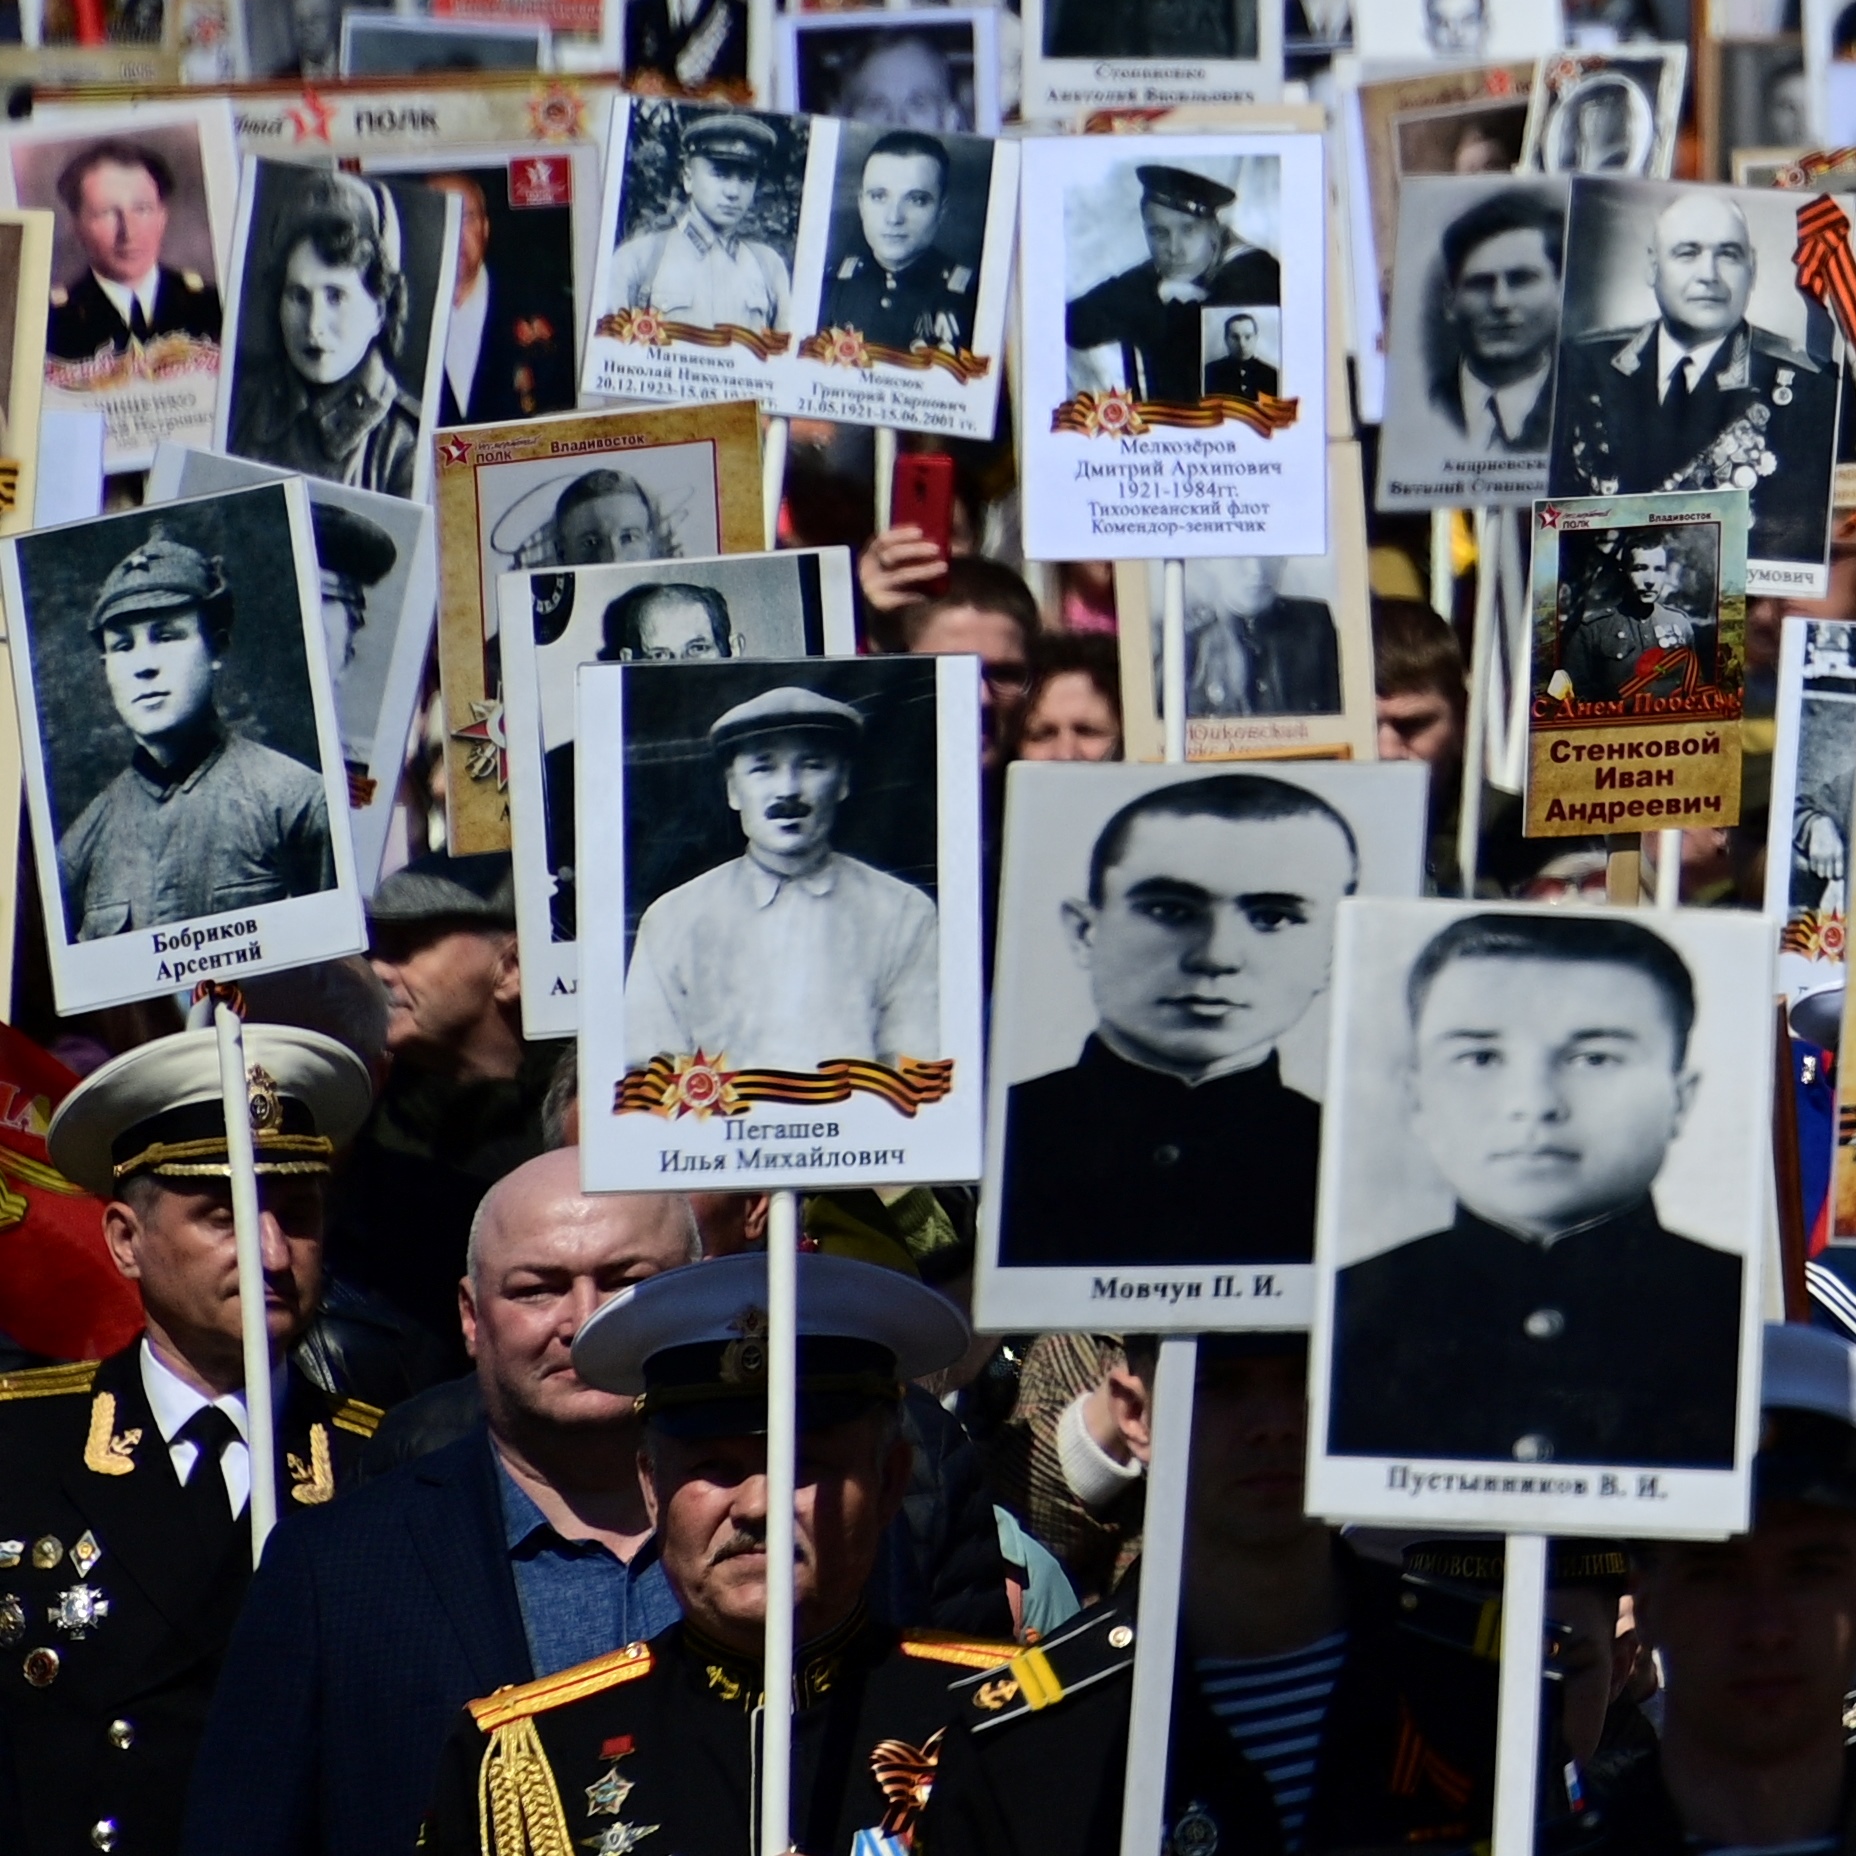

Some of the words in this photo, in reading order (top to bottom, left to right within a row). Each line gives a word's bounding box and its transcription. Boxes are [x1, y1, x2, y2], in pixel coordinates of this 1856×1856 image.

[356, 107, 438, 134] ПОЛК
[550, 434, 645, 454] Владивосток
[1120, 438, 1237, 458] Мелкозёров
[476, 451, 512, 463] ПОЛК
[1075, 460, 1164, 482] Дмитрий
[1171, 461, 1283, 481] Архипович
[1118, 482, 1240, 500] 1921-1984гг.
[1087, 500, 1222, 518] Тихоокеанский
[1227, 500, 1271, 519] флот
[1648, 511, 1712, 523] Владивосток
[1091, 518, 1266, 536] Комендор-зенитчик
[1747, 568, 1815, 585] умович
[1549, 731, 1720, 764] Стенковой
[1595, 766, 1674, 790] Иван
[1545, 795, 1721, 825] Андреевич
[152, 917, 260, 954] Бобриков
[155, 940, 264, 984] Арсентий
[723, 1118, 842, 1144] Пегашев
[658, 1149, 726, 1174] Илья
[735, 1147, 907, 1172] Михайлович
[1090, 1276, 1203, 1304] Мовчун
[1213, 1275, 1242, 1298] П.
[1252, 1275, 1283, 1298] И.
[1599, 1474, 1627, 1498] В.
[1636, 1474, 1669, 1500] И.
